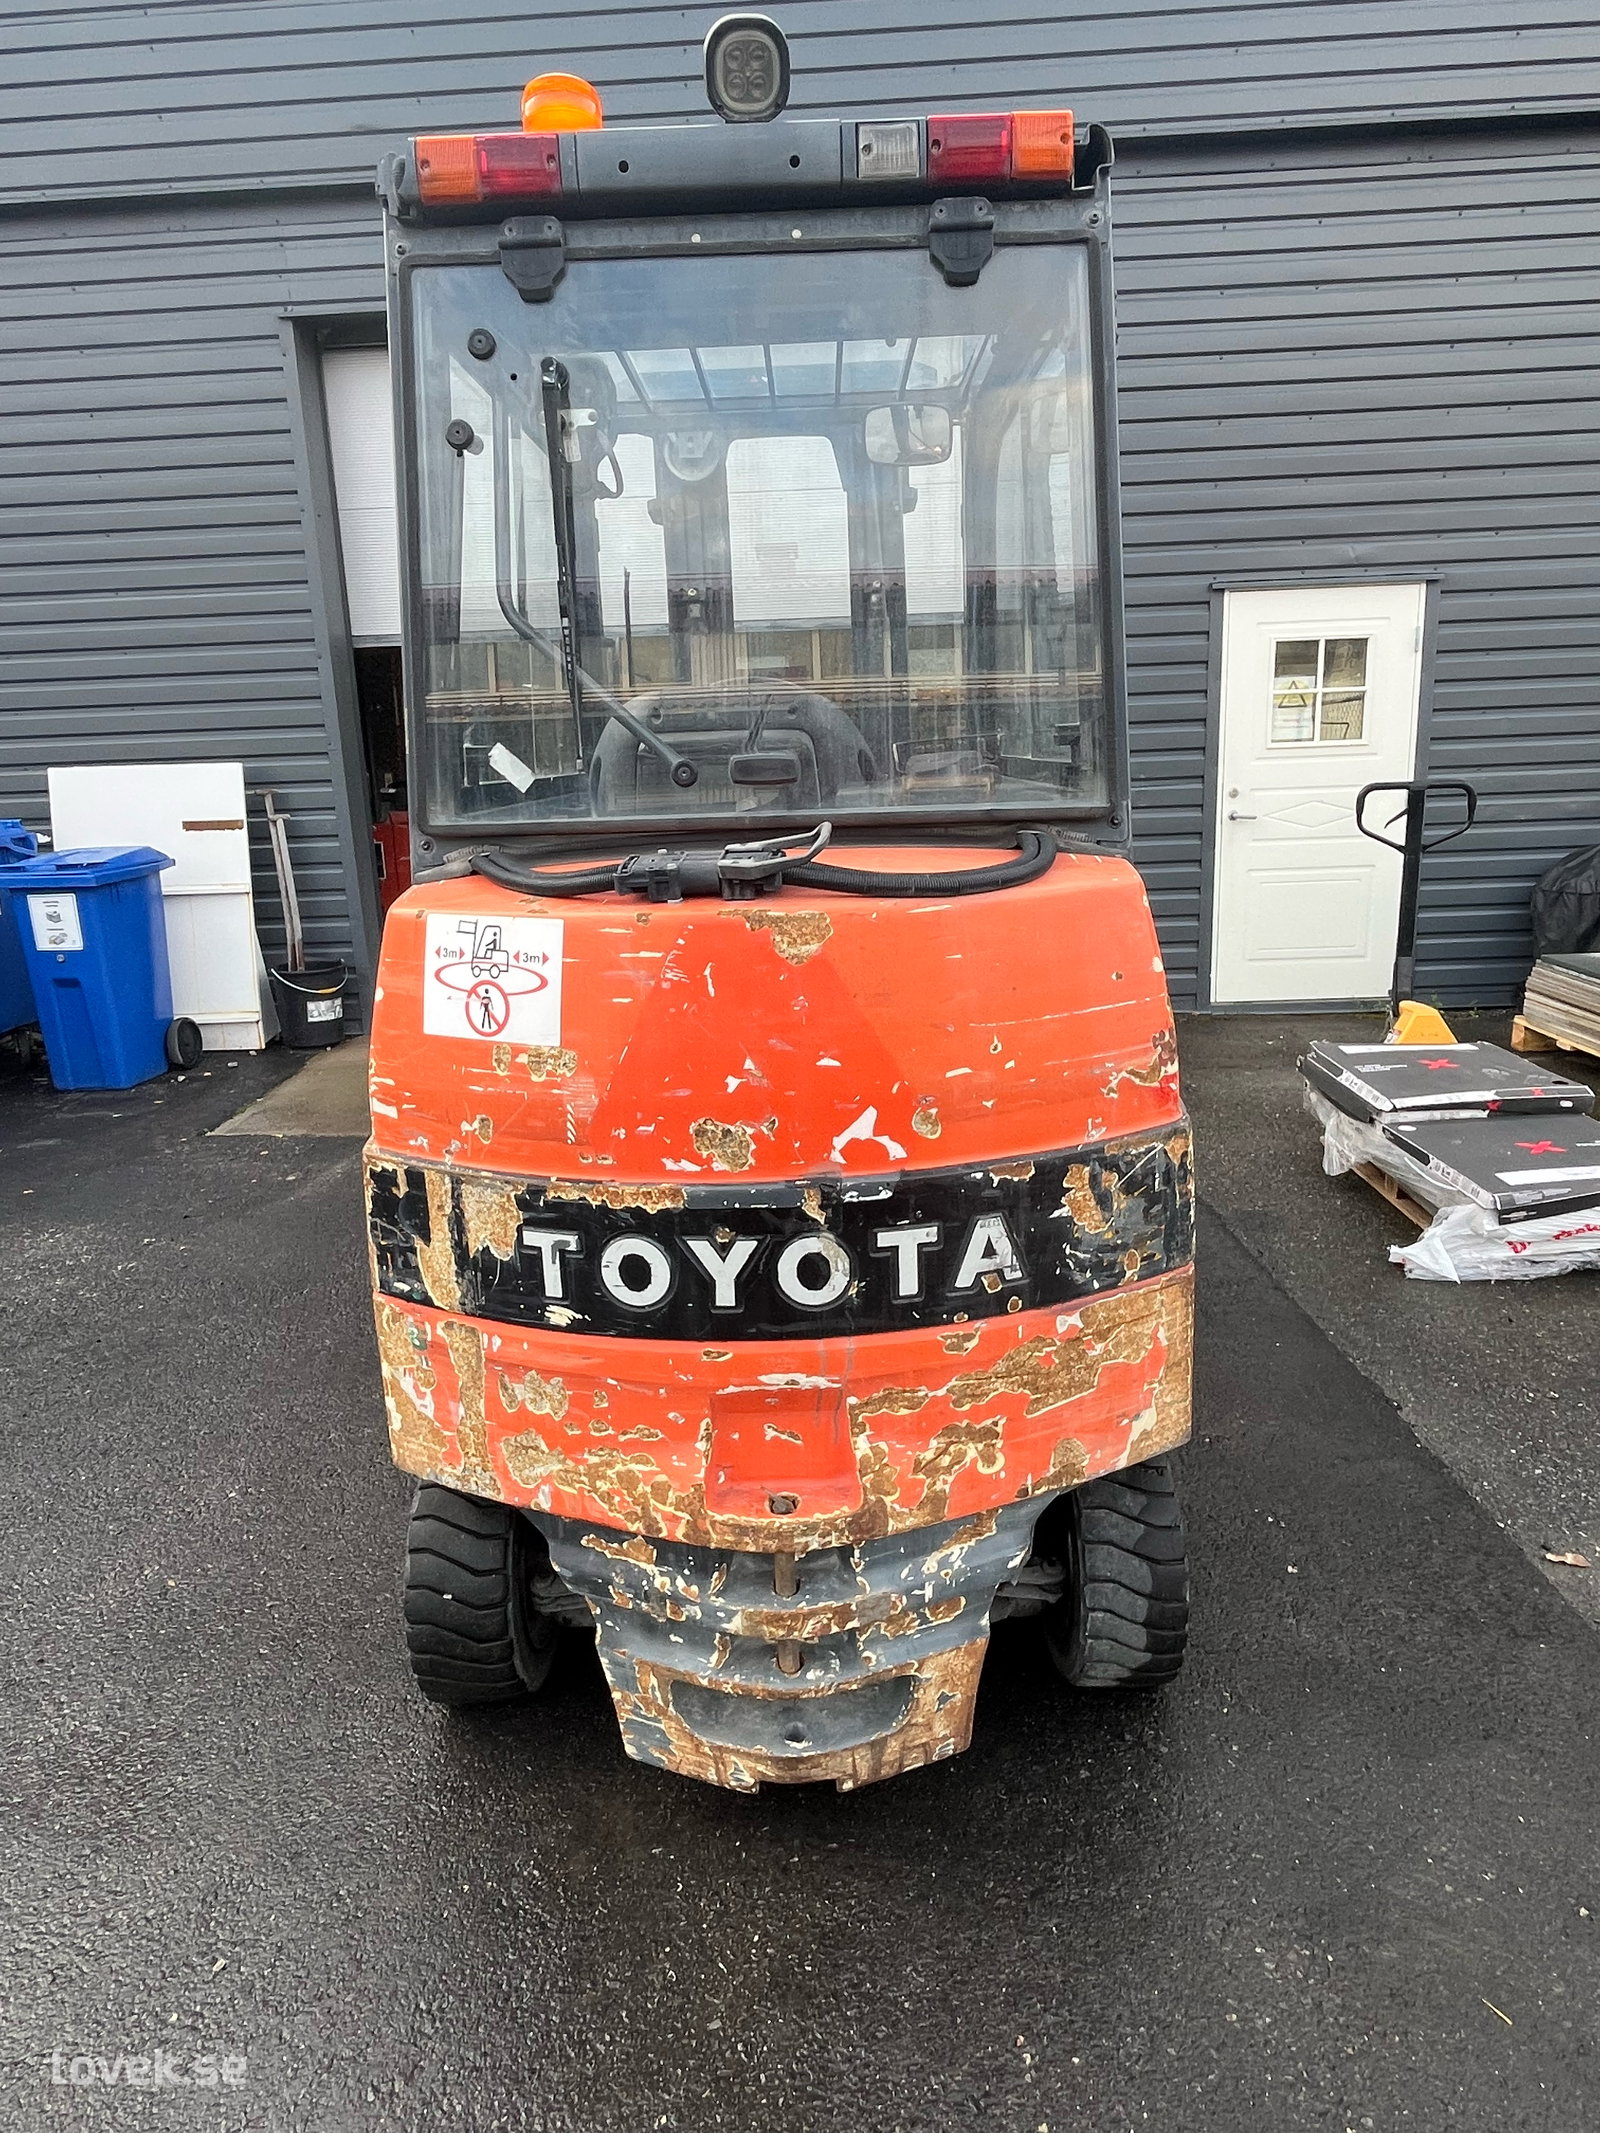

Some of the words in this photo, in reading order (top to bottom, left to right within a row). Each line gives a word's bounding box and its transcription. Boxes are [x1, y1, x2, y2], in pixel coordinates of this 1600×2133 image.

[442, 947, 458, 959] 3m
[522, 952, 540, 964] 3m
[521, 1215, 1026, 1308] TOYOTA
